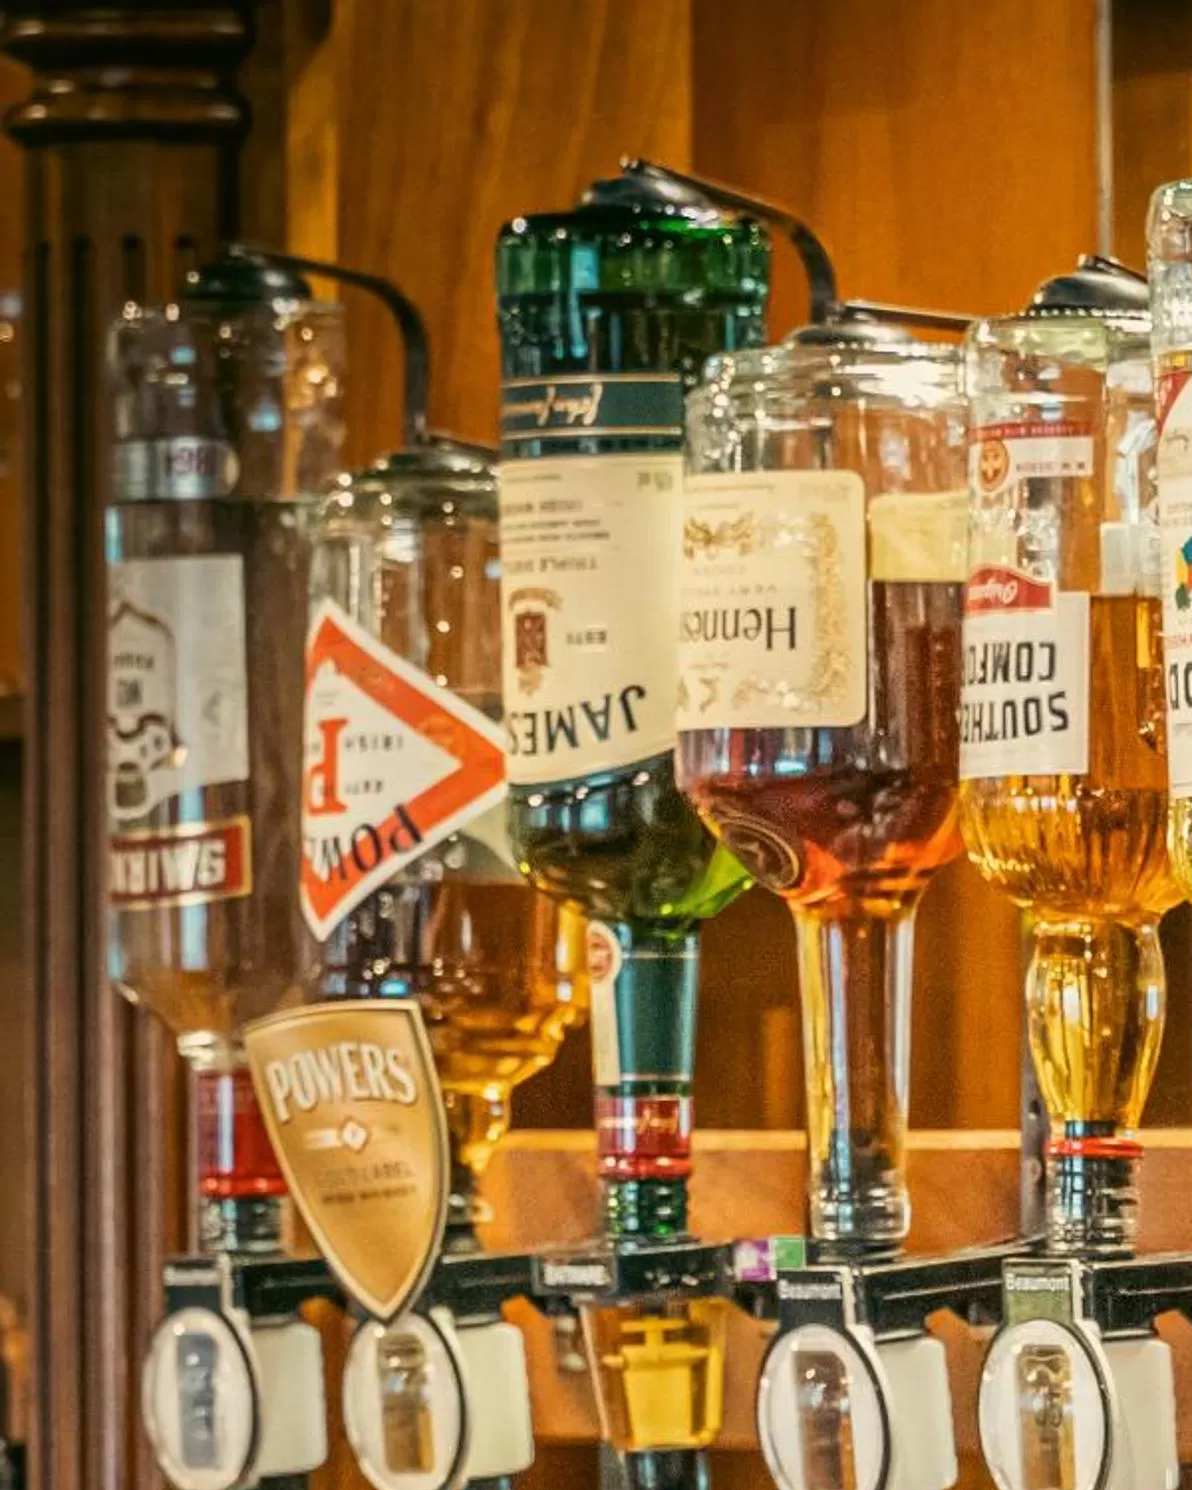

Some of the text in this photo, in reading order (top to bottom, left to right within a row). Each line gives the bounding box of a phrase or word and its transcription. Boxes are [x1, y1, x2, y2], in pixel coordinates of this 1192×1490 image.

[265, 1040, 417, 1122] POWERS
[777, 1278, 841, 1300] Beaumont
[1005, 1273, 1070, 1294] Beaumont
